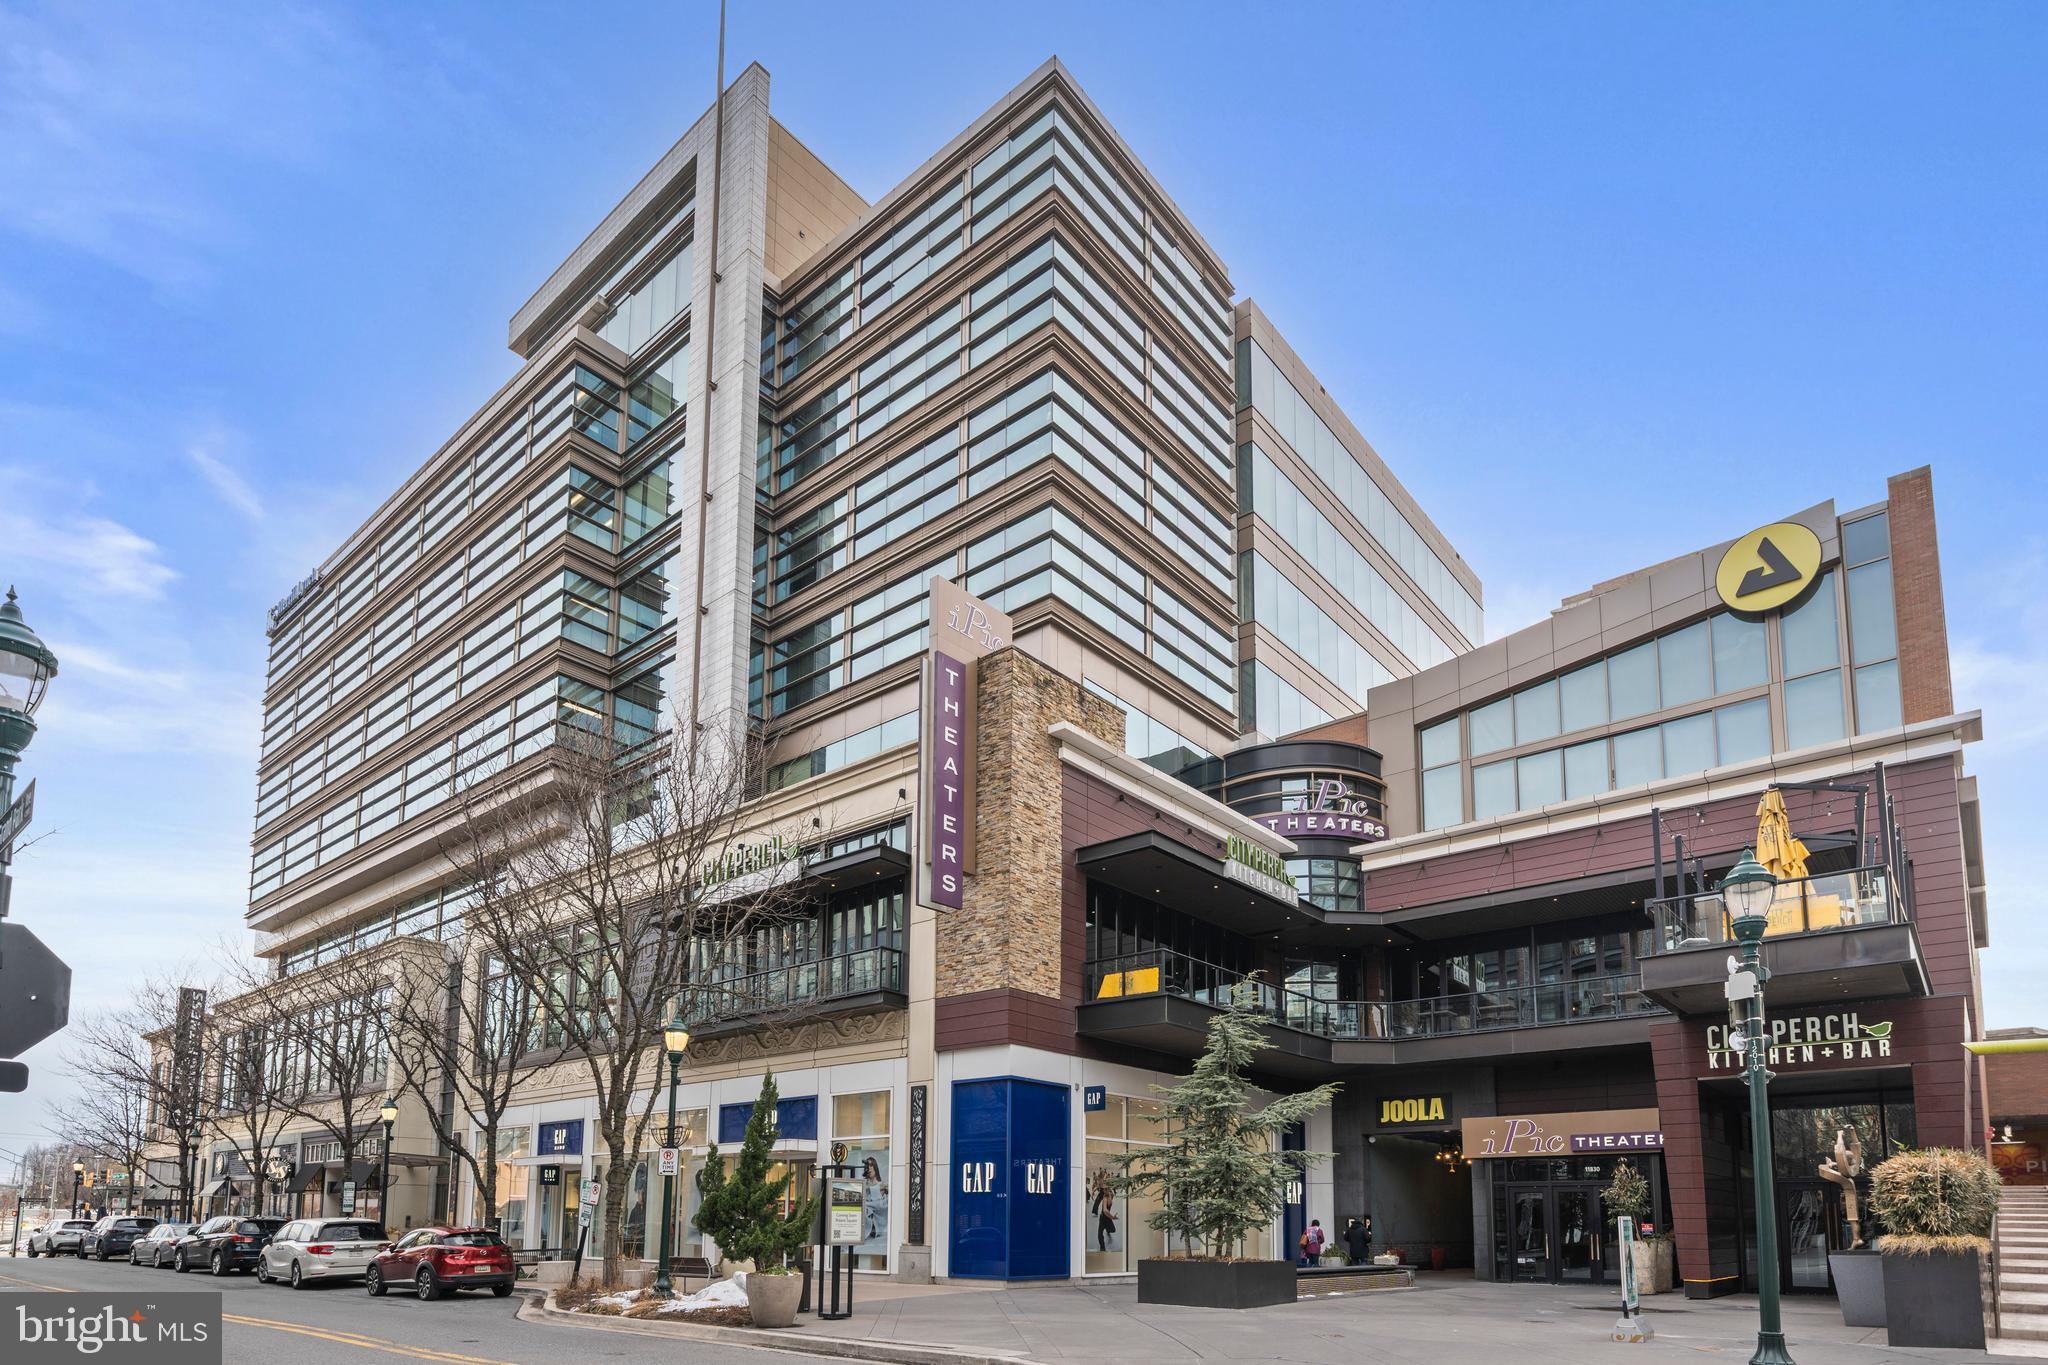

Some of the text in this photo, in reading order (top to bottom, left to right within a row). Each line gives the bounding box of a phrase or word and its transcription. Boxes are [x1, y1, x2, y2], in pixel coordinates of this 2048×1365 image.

[947, 602, 1004, 651] iPic
[942, 667, 959, 893] THEATERS
[1291, 779, 1369, 817] iPic
[1268, 817, 1385, 837] THEATERS
[734, 835, 783, 877] PERCH
[1228, 835, 1288, 883] CITY PERCH
[1771, 1012, 1859, 1044] PERCH
[1708, 1045, 1814, 1069] KITHEN
[1087, 1092, 1101, 1105] GAP
[1381, 1097, 1445, 1123] JOOLA
[554, 1129, 566, 1144] GAP
[1480, 1119, 1565, 1155] iPic
[544, 1169, 556, 1178] GAP
[962, 1162, 995, 1193] GAP
[1026, 1163, 1054, 1194] GAP
[1286, 1181, 1303, 1205] GAP
